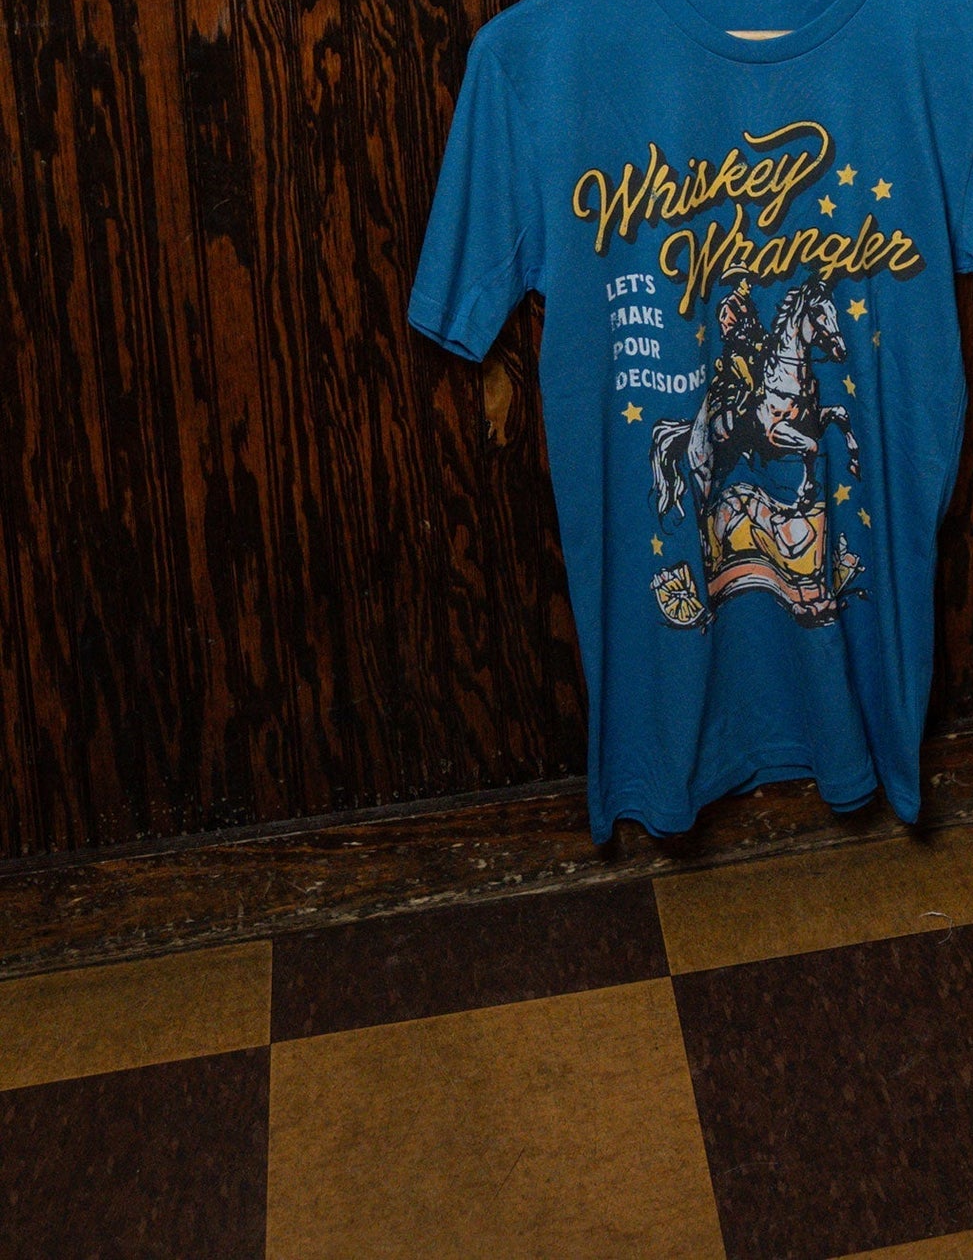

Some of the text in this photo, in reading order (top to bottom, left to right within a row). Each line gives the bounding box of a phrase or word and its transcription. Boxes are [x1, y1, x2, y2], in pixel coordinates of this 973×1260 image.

[571, 119, 833, 254] Whiskey
[606, 273, 656, 302] LET'S
[658, 203, 922, 315] Wrangler
[613, 336, 661, 361] POUR
